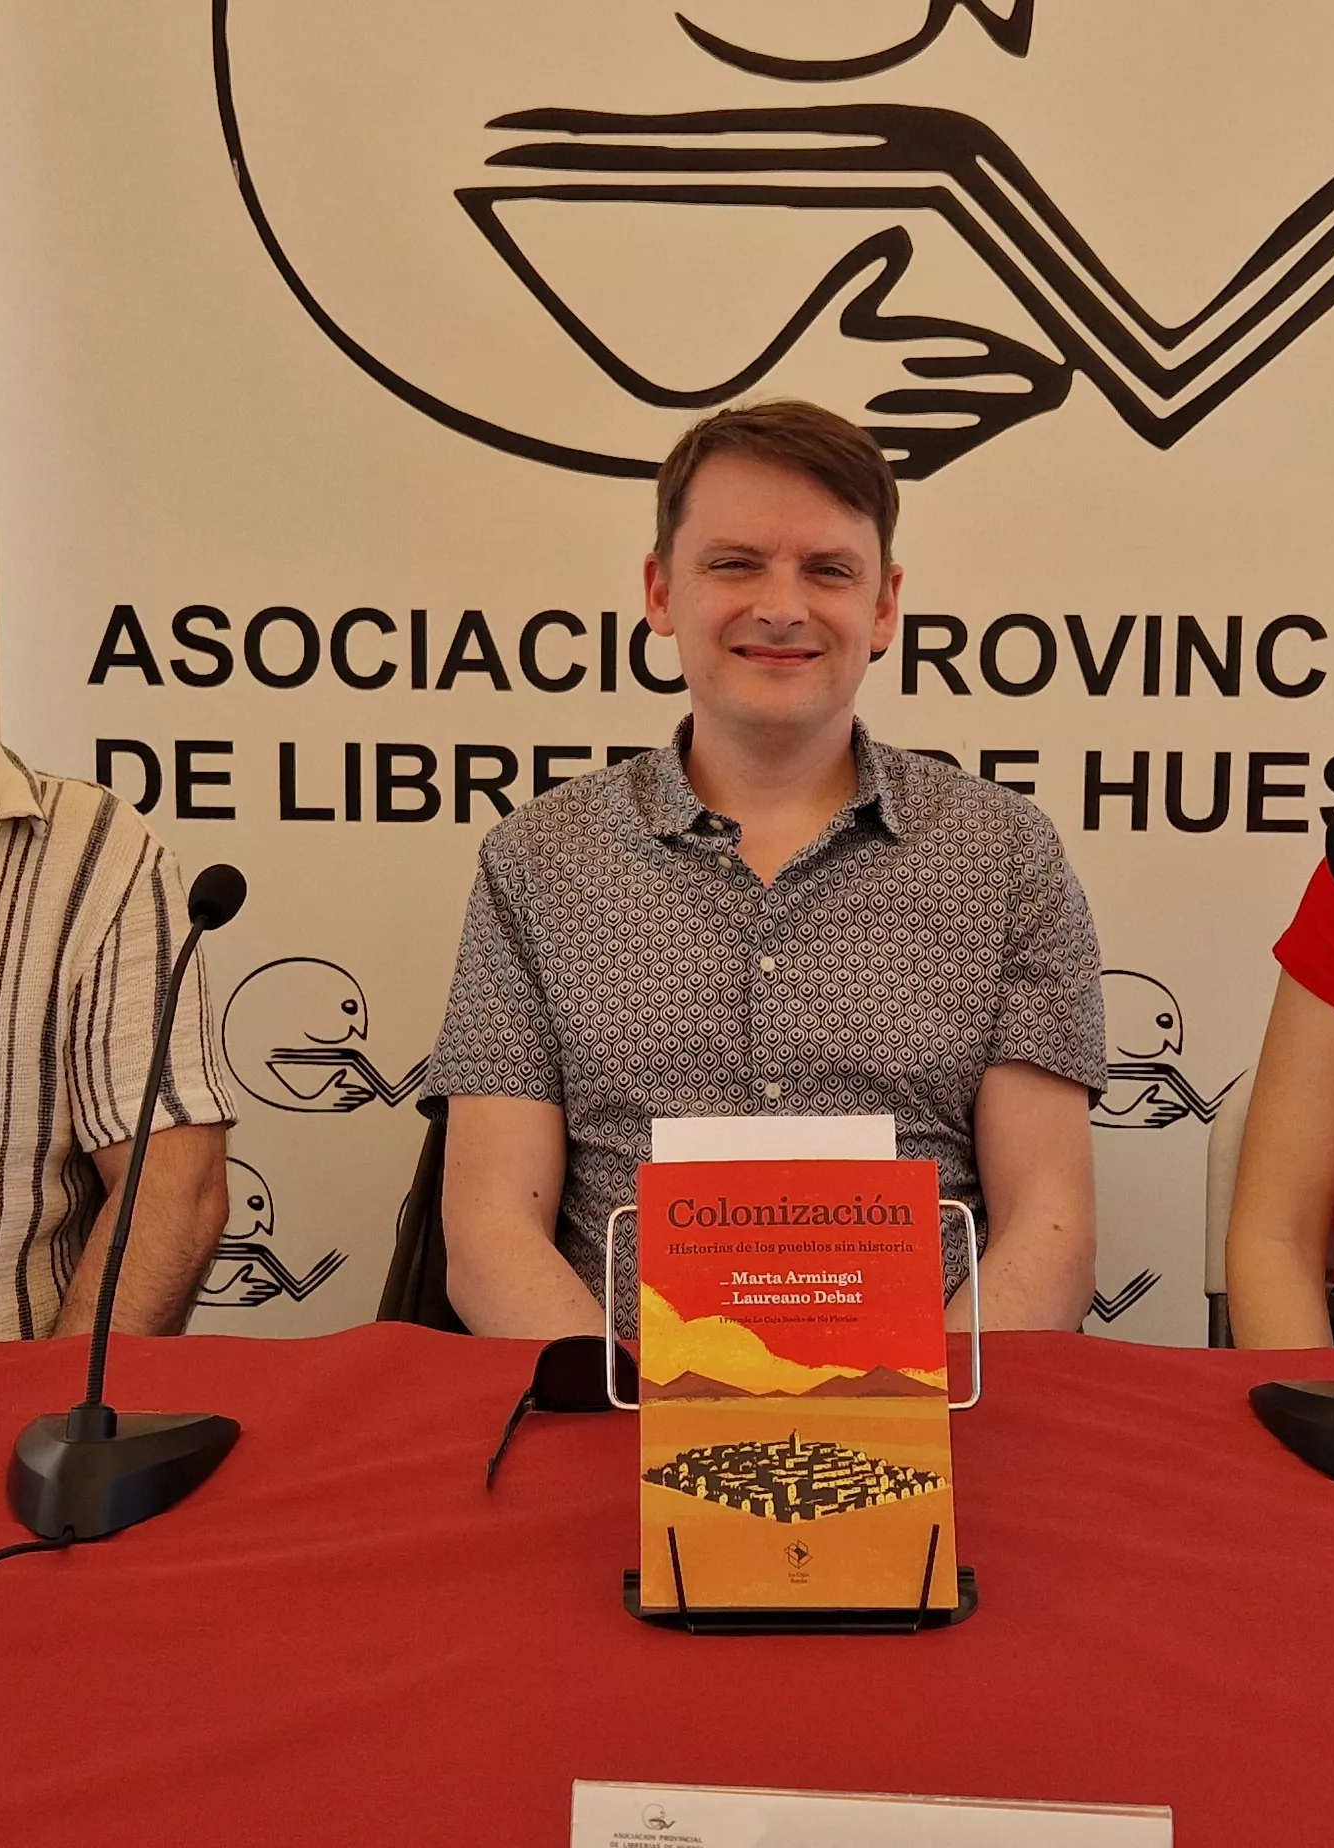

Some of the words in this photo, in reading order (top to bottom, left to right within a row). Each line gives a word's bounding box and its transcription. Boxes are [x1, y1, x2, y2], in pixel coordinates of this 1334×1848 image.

[95, 738, 236, 820] DE
[668, 1194, 914, 1229] Colonización
[668, 1242, 733, 1255] Historias
[736, 1241, 752, 1254] de
[755, 1241, 775, 1253] los
[777, 1240, 832, 1255] pueblos
[834, 1240, 856, 1253] sin
[857, 1240, 914, 1253] historia
[731, 1271, 783, 1285] Marta
[784, 1269, 863, 1287] Armingol
[732, 1291, 811, 1305] Laureano
[813, 1290, 863, 1304] Debat
